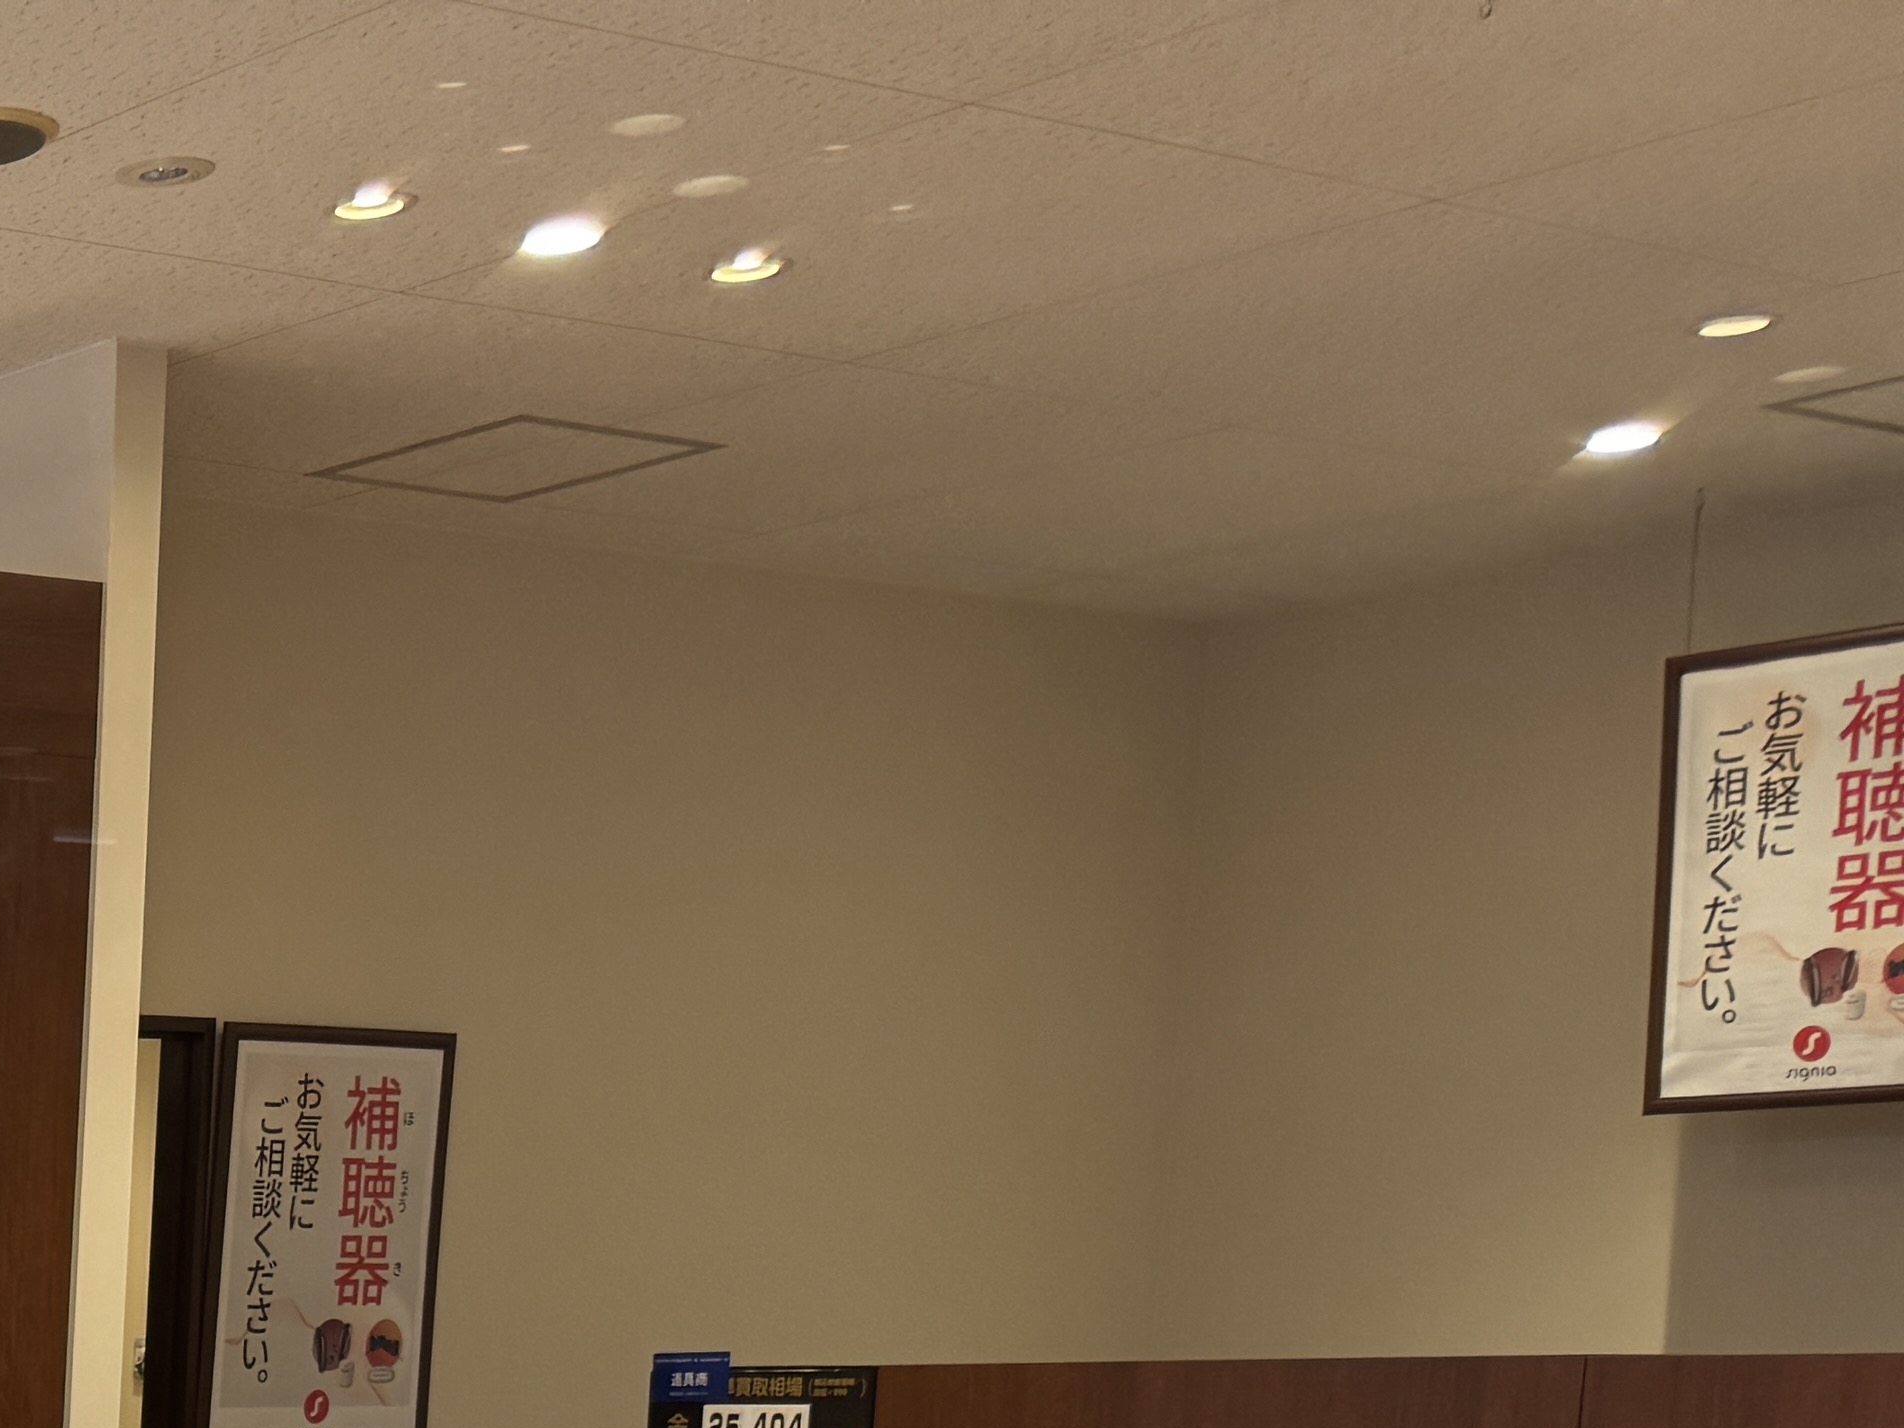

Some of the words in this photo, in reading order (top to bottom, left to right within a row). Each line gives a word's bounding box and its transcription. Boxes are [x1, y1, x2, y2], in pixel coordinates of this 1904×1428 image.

[1700, 720, 1754, 1025] ご相談ください。
[1757, 690, 1807, 860] お気軽に
[290, 1072, 325, 1231] お気軽に
[1785, 1064, 1838, 1082] signia
[242, 1096, 289, 1384] ご相談ください。
[334, 1074, 402, 1307] 補聴器
